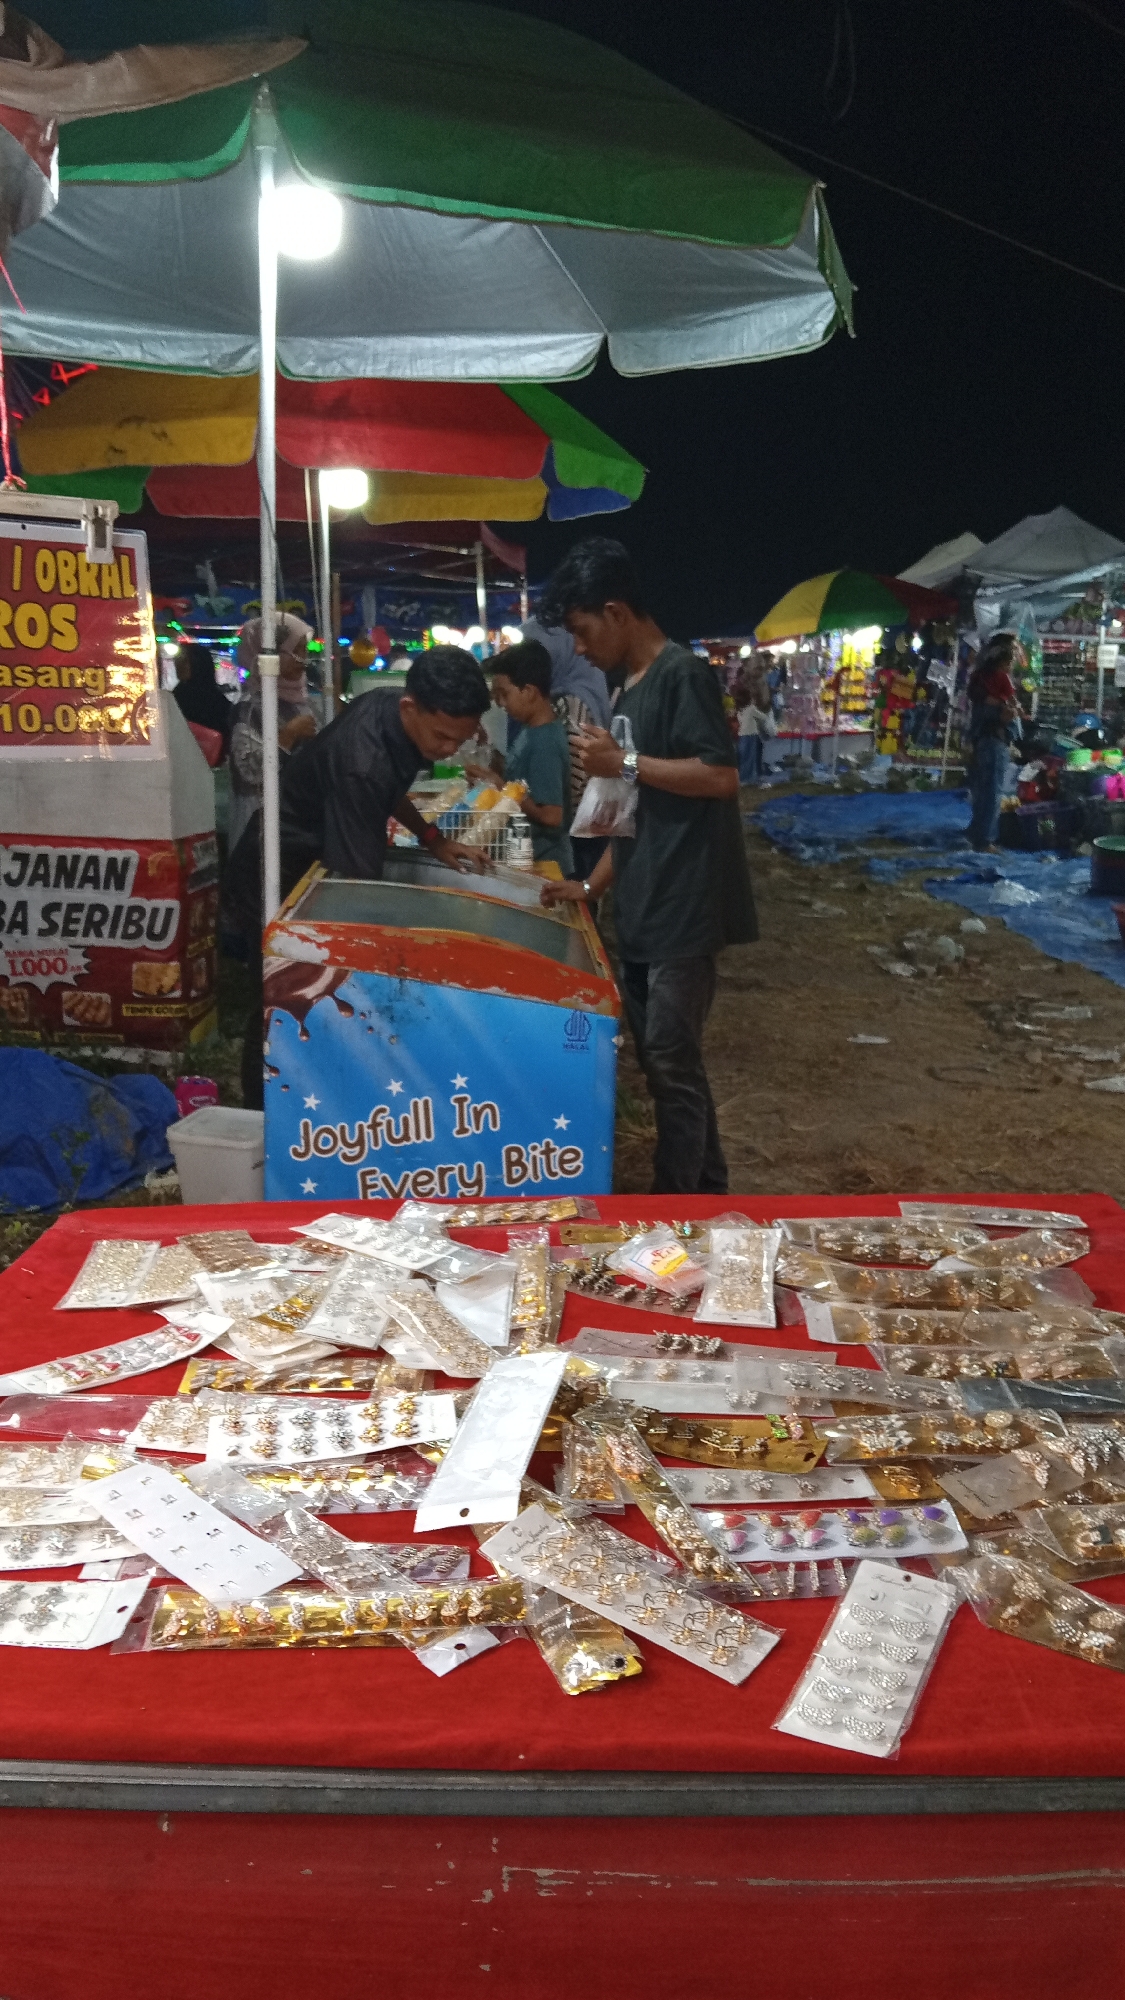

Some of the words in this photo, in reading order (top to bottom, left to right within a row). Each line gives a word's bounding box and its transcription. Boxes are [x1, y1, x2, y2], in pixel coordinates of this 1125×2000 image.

[0, 852, 131, 891] JANAN
[0, 900, 29, 937] A
[37, 902, 175, 943] SERIBU
[290, 1096, 434, 1165] Joyfull
[451, 1094, 500, 1136] In
[358, 1162, 485, 1199] Every
[502, 1140, 584, 1187] Bite
